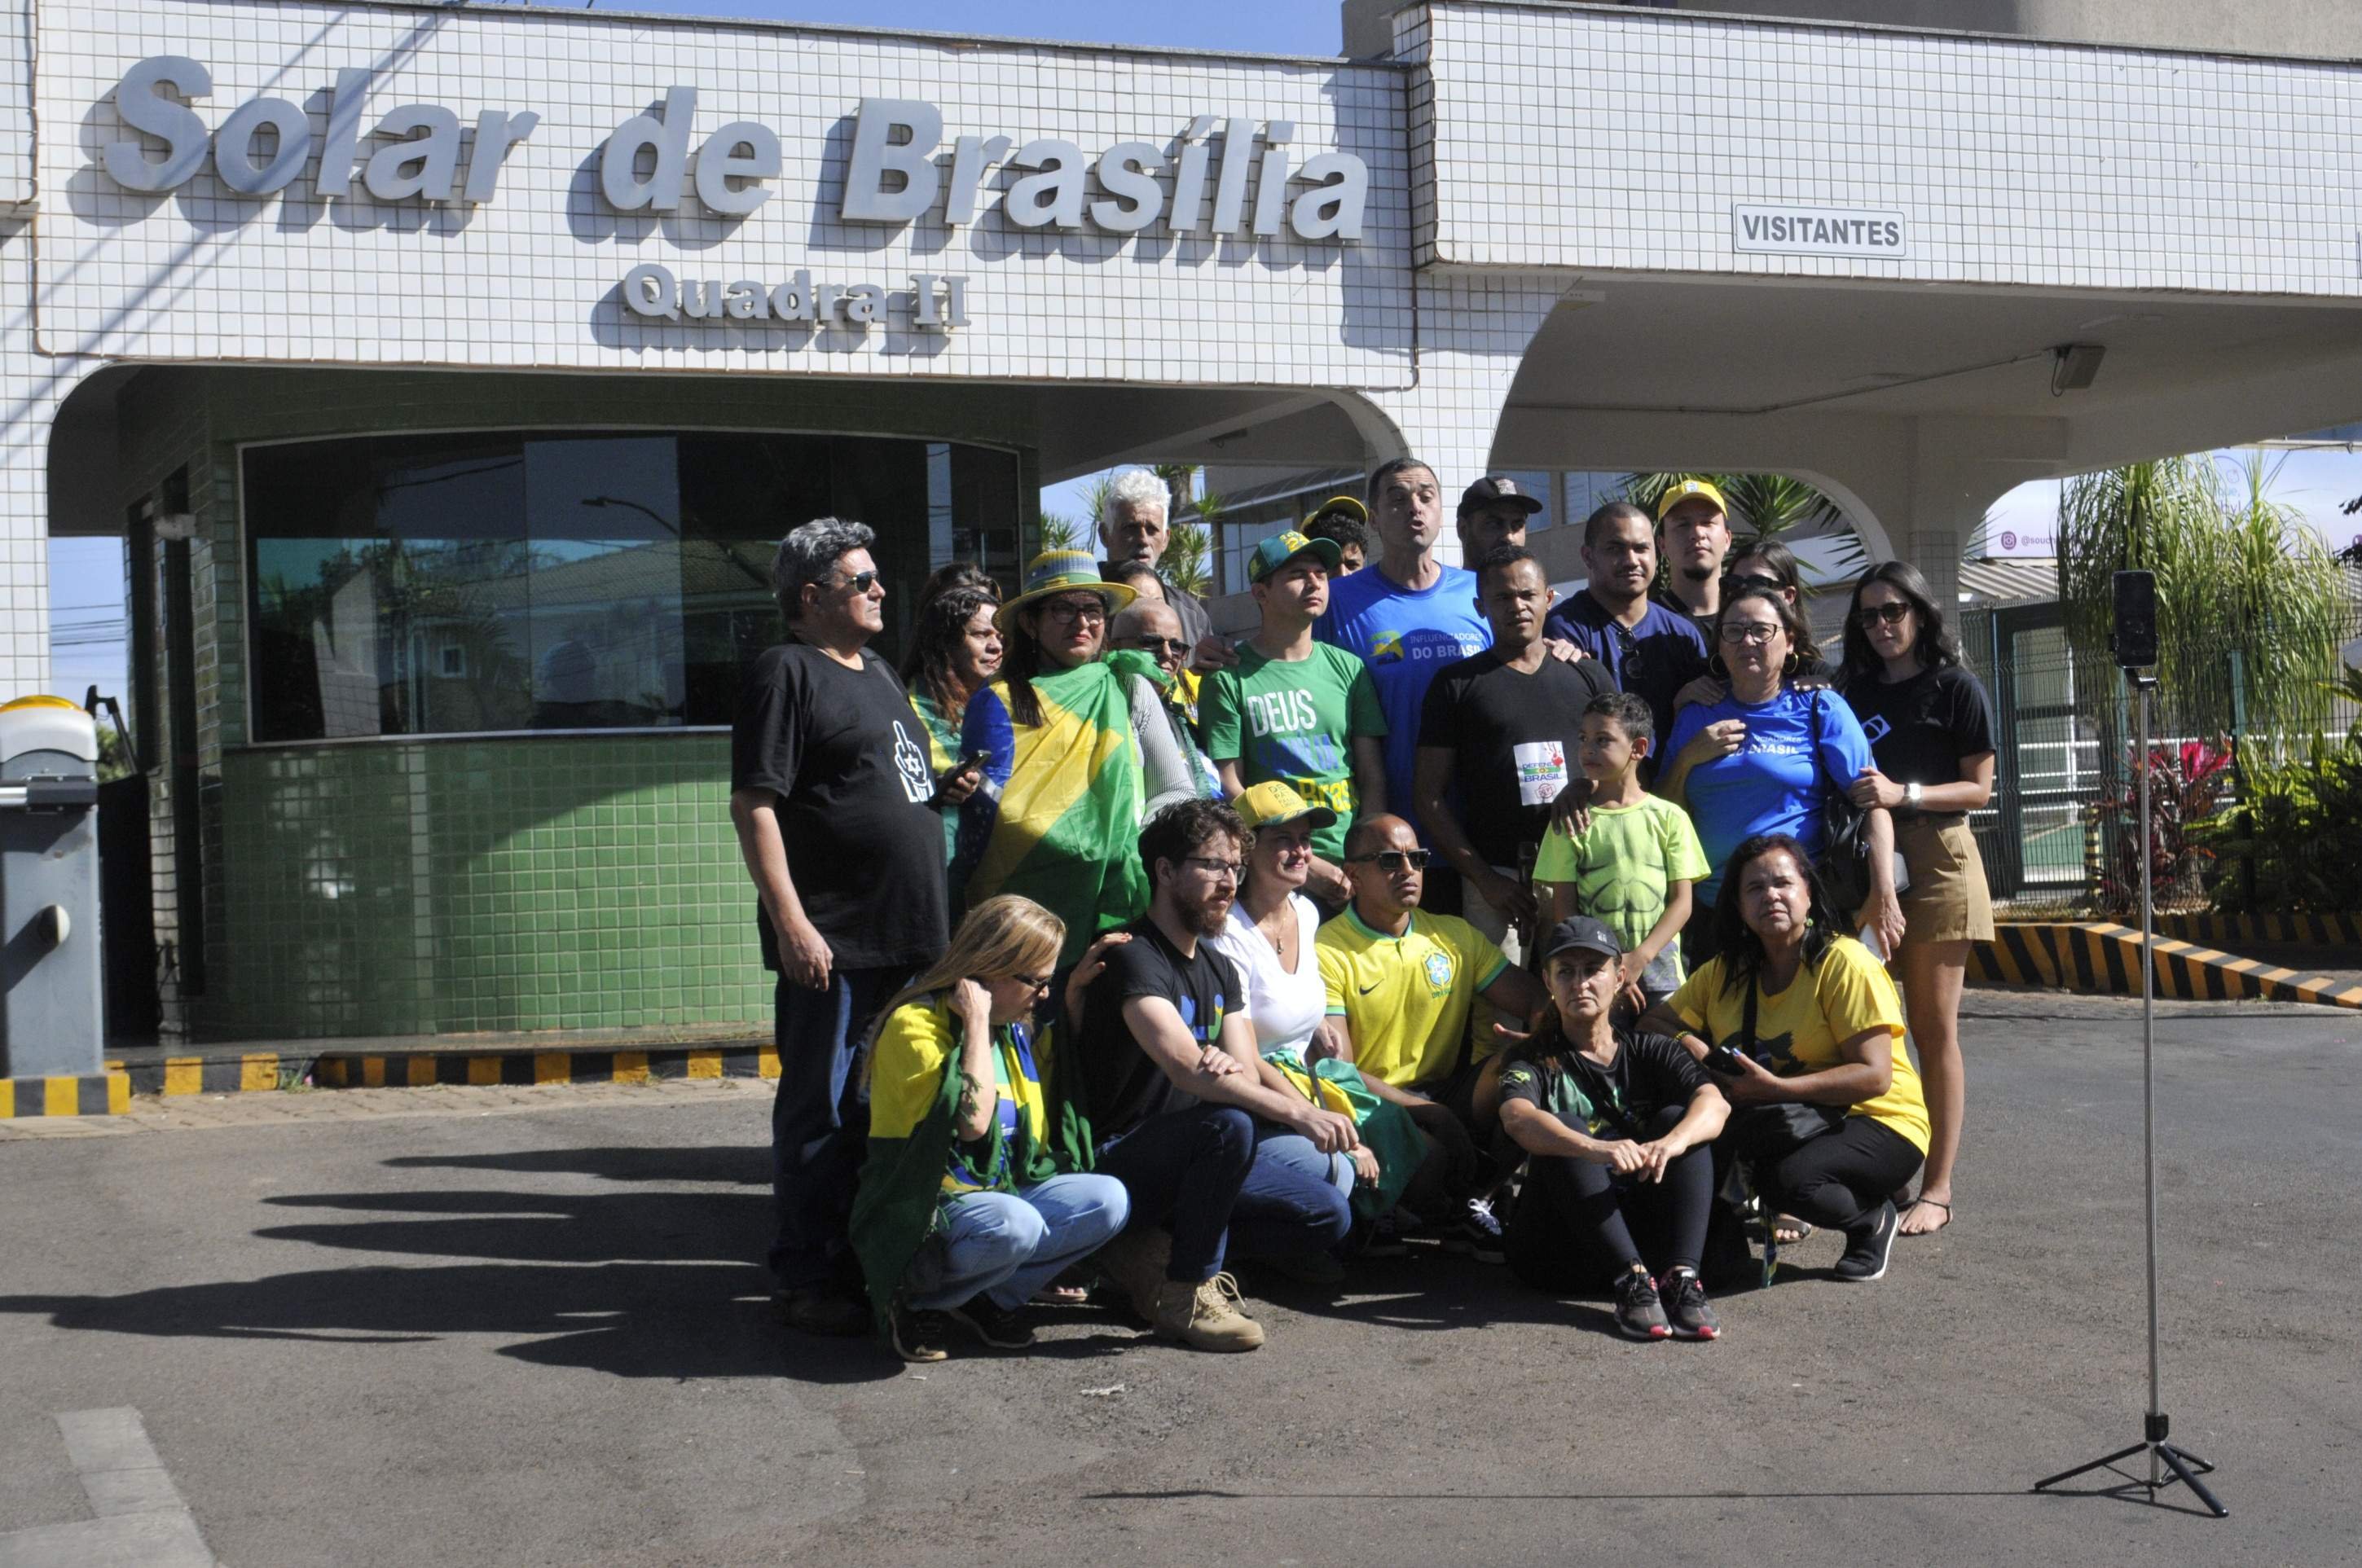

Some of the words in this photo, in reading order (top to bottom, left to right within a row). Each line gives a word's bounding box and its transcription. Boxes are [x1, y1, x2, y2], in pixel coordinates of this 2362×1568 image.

[103, 55, 540, 204] Solar
[601, 86, 781, 217] de
[842, 97, 1369, 241] Brasília
[1742, 214, 1900, 247] VISITANTES
[623, 263, 887, 323] Quadra
[910, 274, 971, 327] II
[1412, 647, 1432, 660] DO
[1247, 689, 1317, 737] DEUS
[1524, 773, 1562, 783] BRASIL
